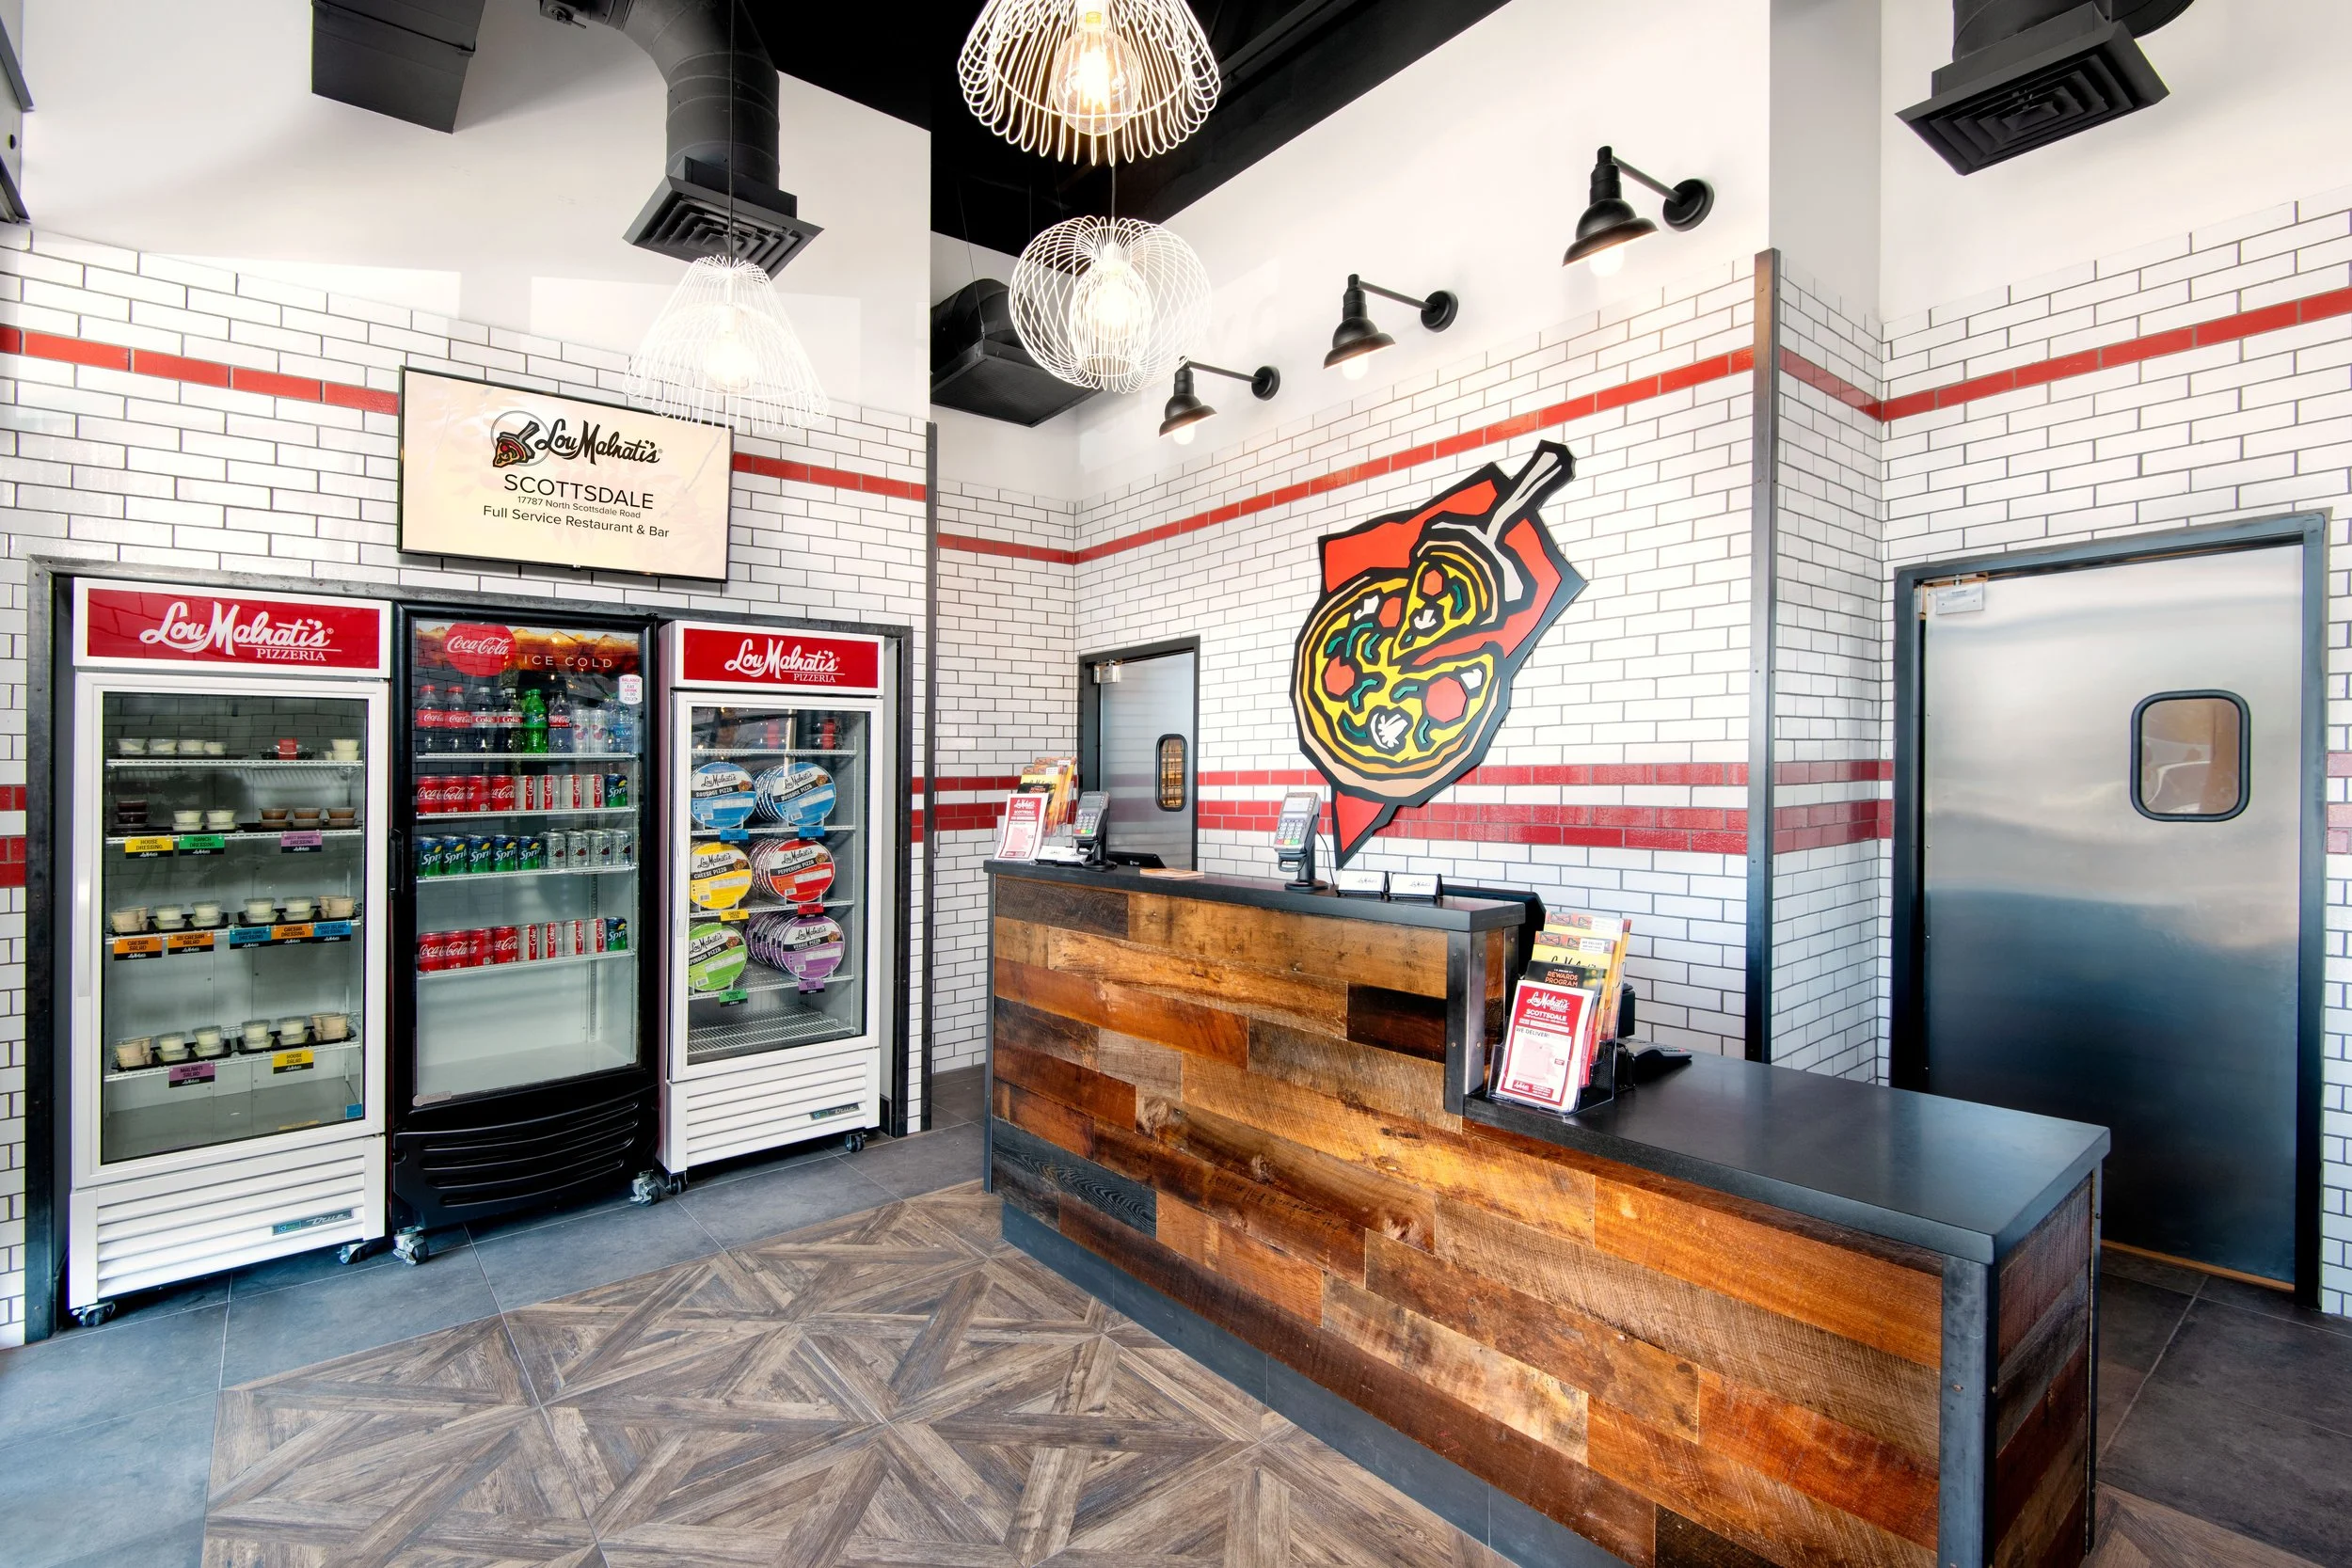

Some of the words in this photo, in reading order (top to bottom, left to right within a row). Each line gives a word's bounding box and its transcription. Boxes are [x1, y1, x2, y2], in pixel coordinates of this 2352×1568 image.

[534, 419, 578, 461] Lou
[575, 420, 660, 466] Malnati's
[504, 474, 654, 510] SCOTTSDALE
[517, 496, 543, 506] 17787
[546, 499, 570, 510] North
[572, 502, 618, 516] Scottsdale
[620, 509, 641, 519] Road
[484, 505, 508, 519] Full
[512, 508, 562, 526] Service
[565, 515, 634, 533] Restaurant
[636, 523, 646, 535] &
[649, 524, 670, 539] Bar
[139, 601, 206, 653] Lou
[203, 601, 330, 656] Malnati's
[447, 635, 513, 656] Coca-Cola
[256, 648, 326, 662] PIZZERIA
[523, 655, 554, 666] ICE
[564, 657, 612, 669] COLD
[724, 638, 765, 677] Lou
[763, 638, 838, 679] Malnati's
[793, 673, 836, 683] PIZZERIA
[608, 785, 626, 797] Spri
[712, 866, 727, 876] PIZZA
[778, 863, 802, 875] PEPPERONI
[689, 953, 707, 965] PINACH
[1545, 977, 1579, 987] PROGRAM
[1548, 971, 1578, 981] REWARDS
[1526, 1008, 1567, 1022] SCOTTSDALE
